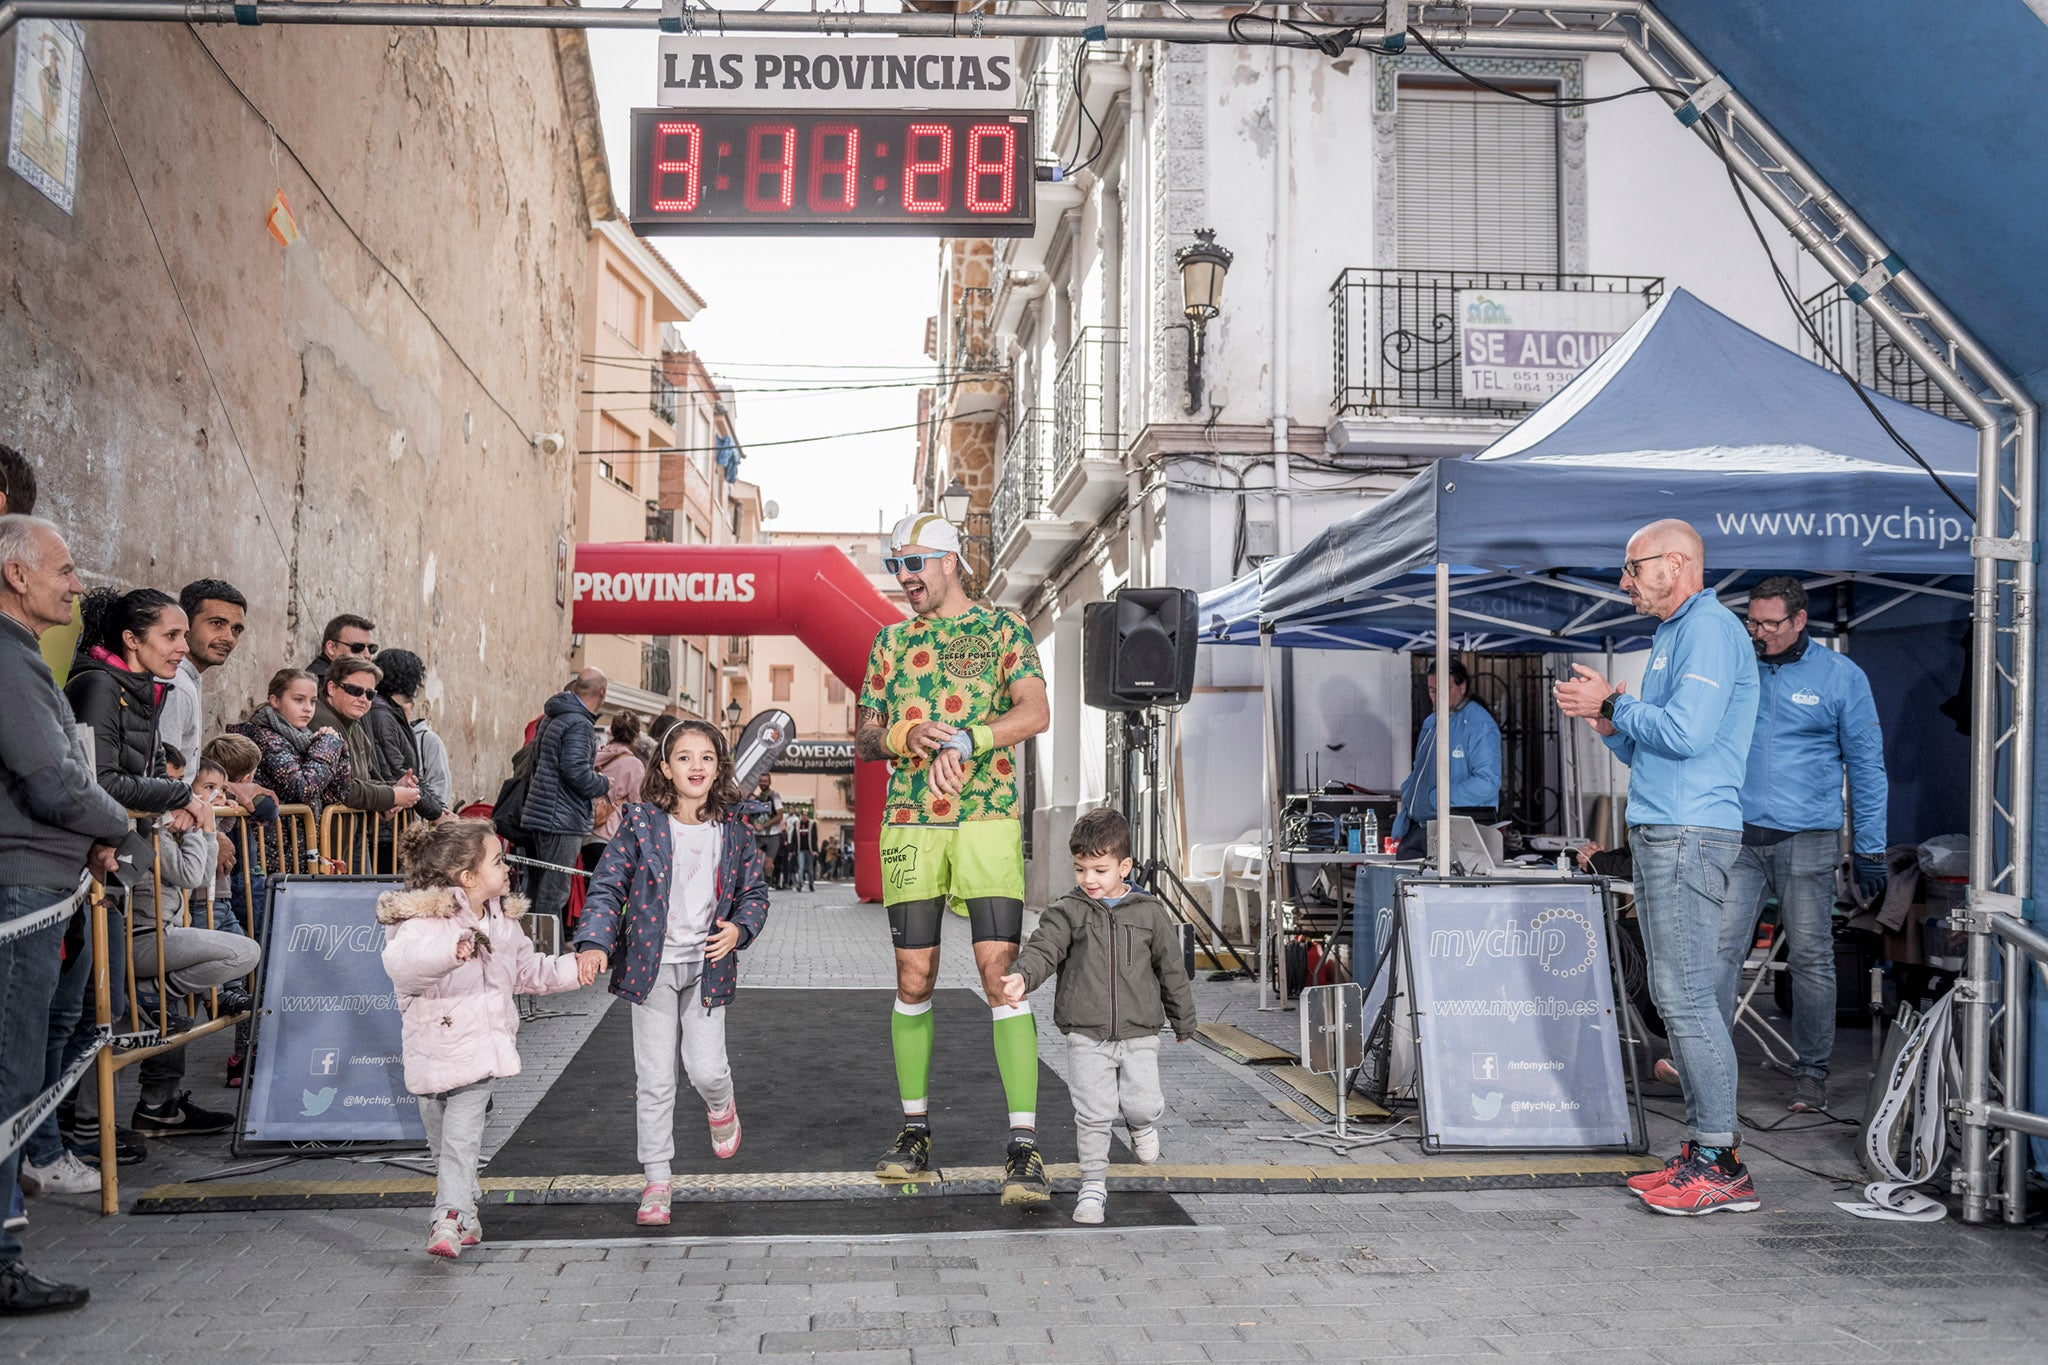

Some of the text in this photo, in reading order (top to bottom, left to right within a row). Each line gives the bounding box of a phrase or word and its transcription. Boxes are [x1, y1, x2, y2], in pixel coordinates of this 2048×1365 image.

[664, 54, 1011, 91] LAS PROVINCIAS
[1470, 332, 1614, 367] SE ALQUI
[1513, 371, 1539, 381] 651
[1513, 383, 1541, 392] 964
[1716, 506, 1976, 549] www.mychip.
[573, 572, 755, 602] PROVINCIAS
[968, 651, 997, 659] POWER
[804, 760, 824, 769] para
[884, 854, 907, 864] POWER
[1430, 920, 1566, 966] mychip
[1433, 997, 1600, 1020] www.mychip.es
[1507, 1061, 1565, 1071] /infomychip
[343, 1095, 416, 1106] @Mychip_Info
[1510, 1101, 1580, 1111] @Mychip_Info
